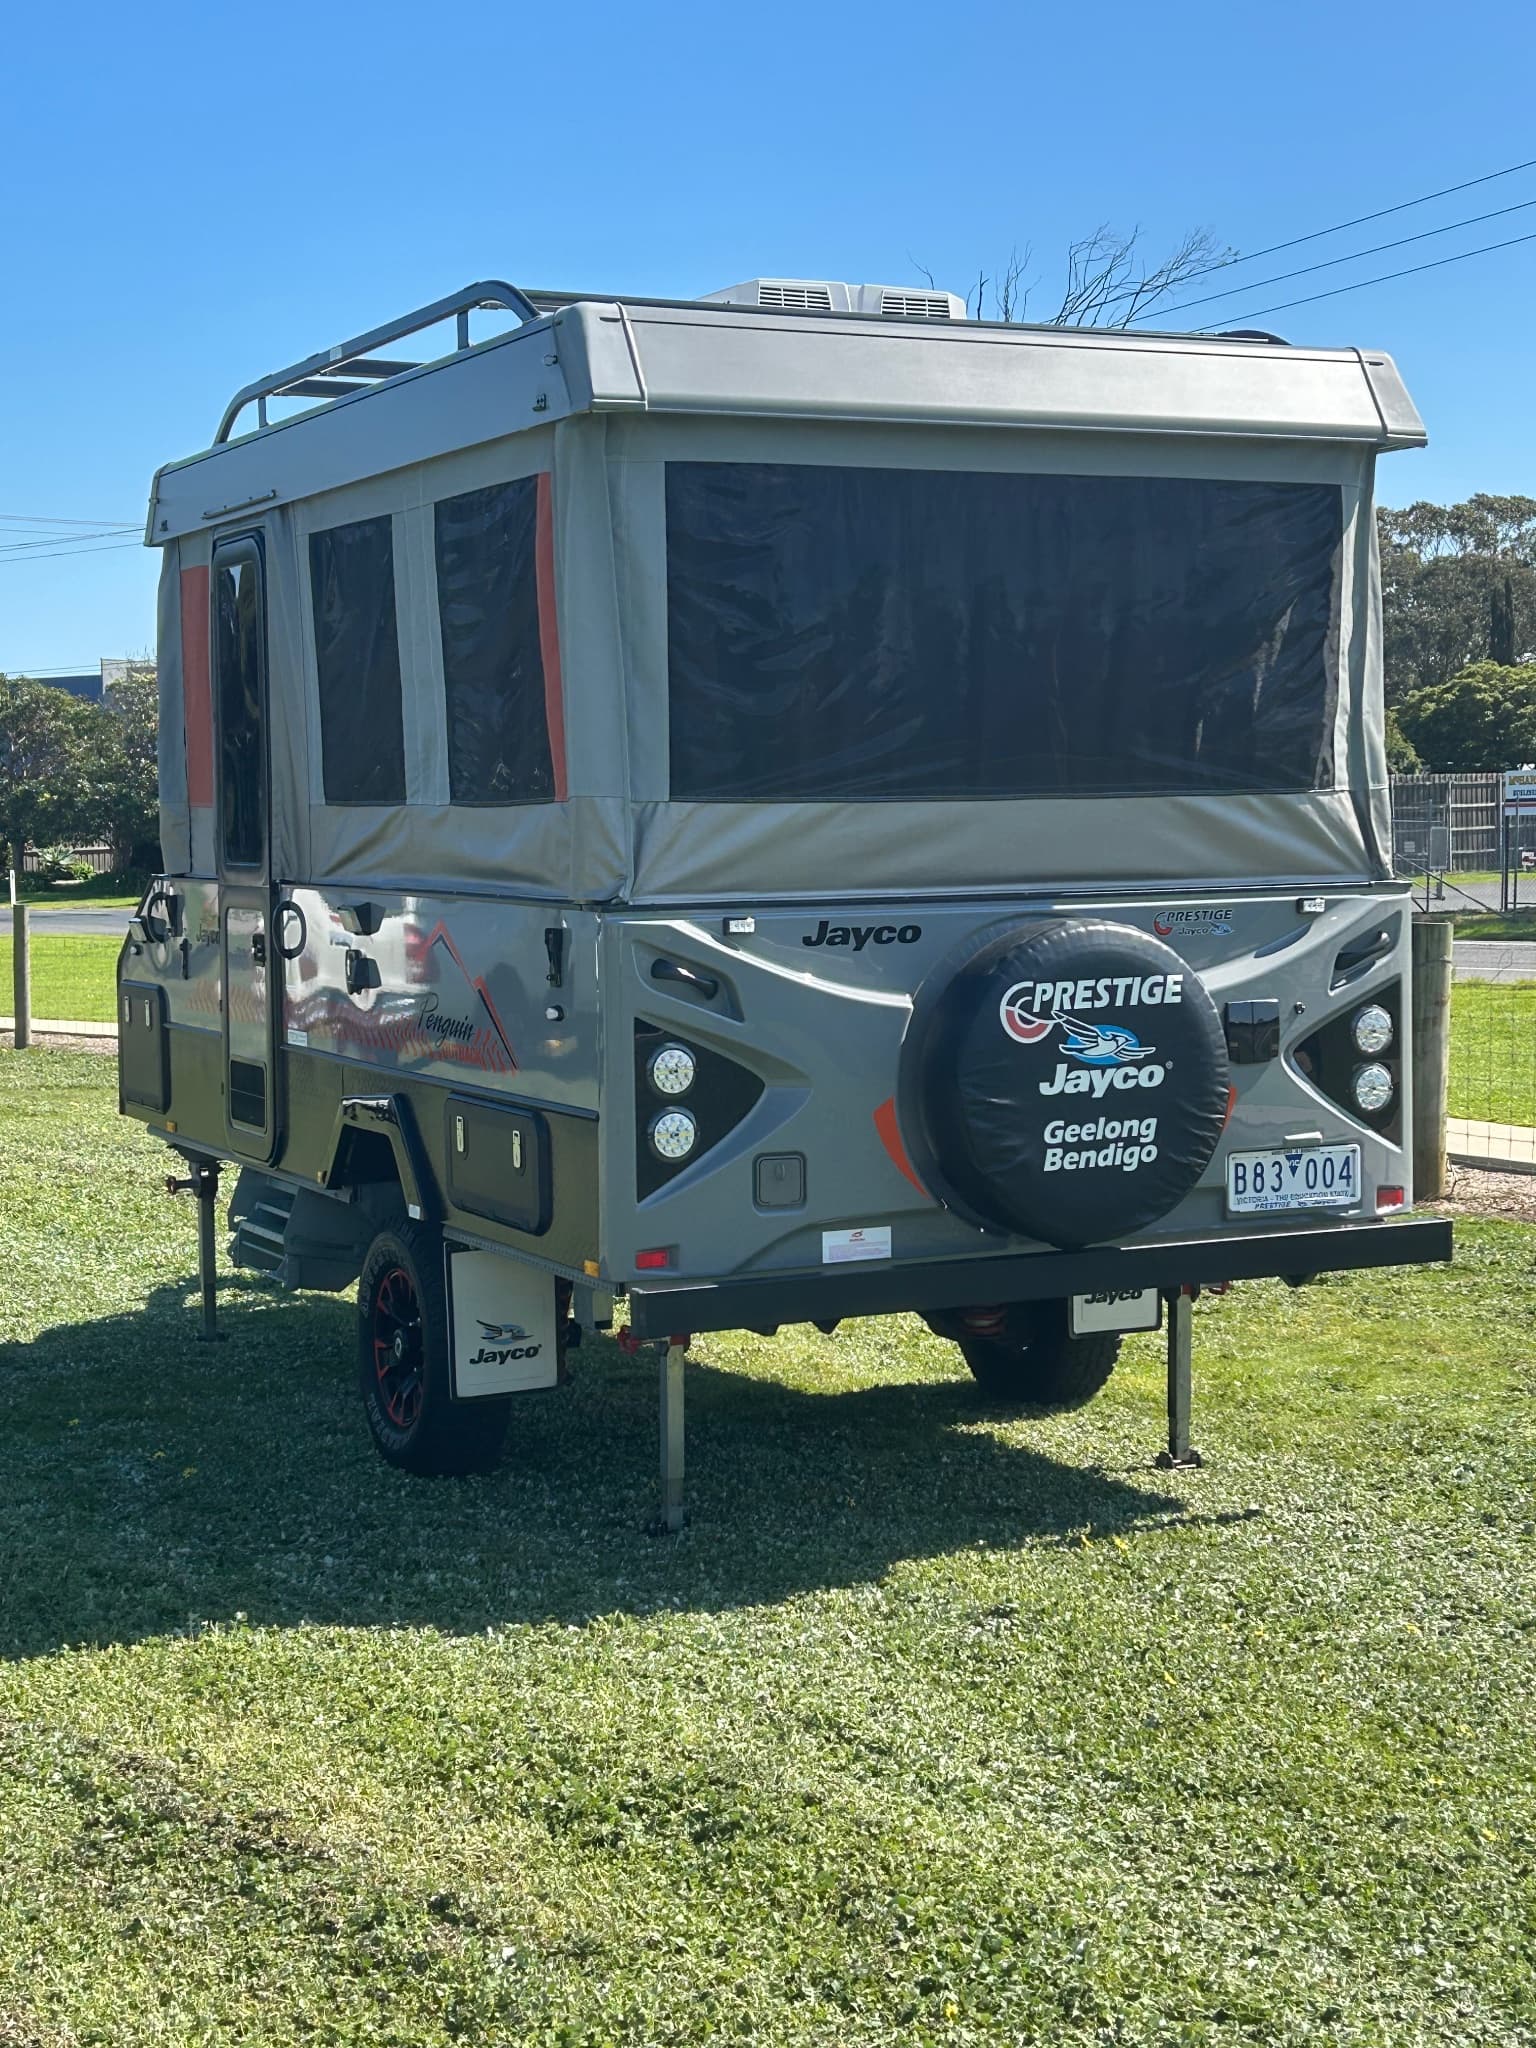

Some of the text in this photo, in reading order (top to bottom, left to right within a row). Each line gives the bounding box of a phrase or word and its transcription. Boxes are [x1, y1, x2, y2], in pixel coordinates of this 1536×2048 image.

[1166, 909, 1233, 922] PRESTIGE
[802, 921, 922, 951] Jayco
[1178, 926, 1210, 936] Jayco
[1033, 974, 1184, 1013] PRESTIGE
[417, 991, 474, 1048] Penguin
[1039, 1062, 1167, 1098] Jayco
[1043, 1117, 1158, 1144] Geelong
[1043, 1142, 1158, 1172] Bendigo
[1234, 1155, 1353, 1195] B83 004
[1084, 1287, 1143, 1305] Jayco
[469, 1344, 540, 1365] Jayco
